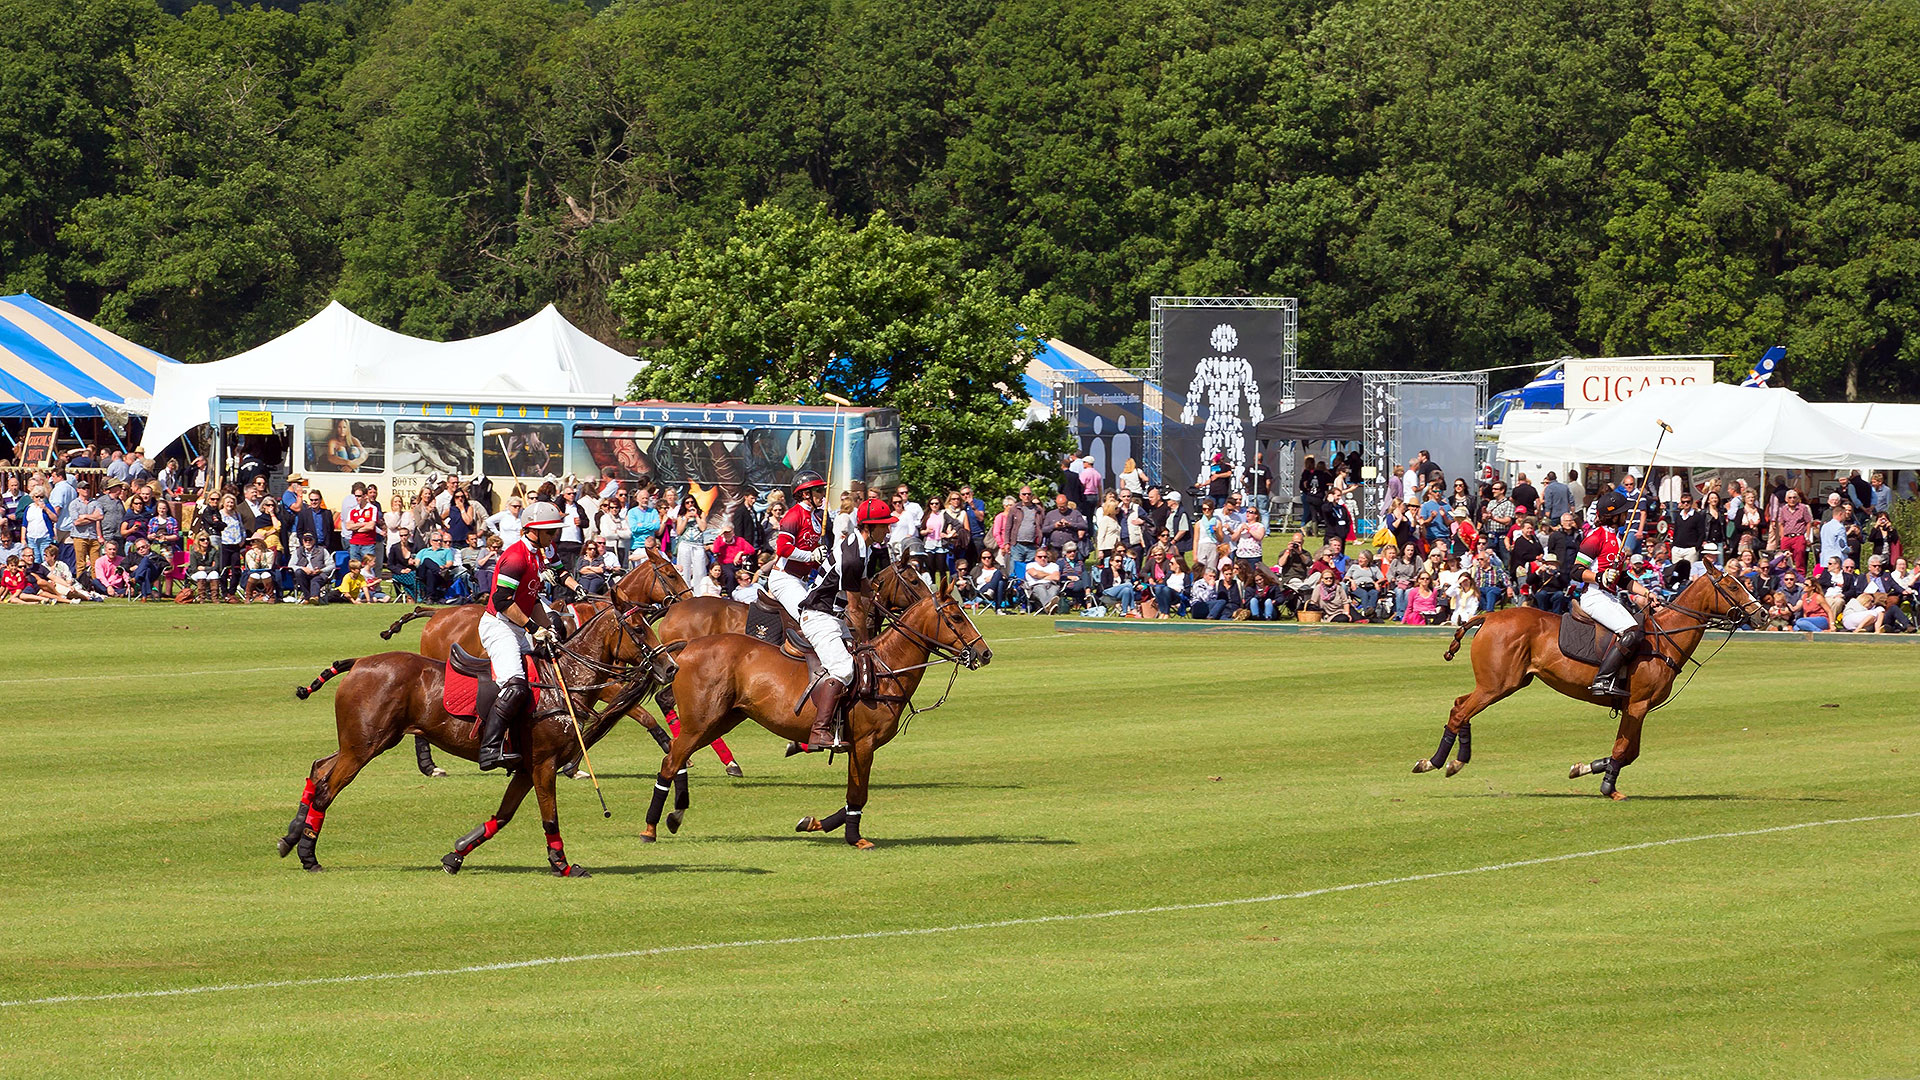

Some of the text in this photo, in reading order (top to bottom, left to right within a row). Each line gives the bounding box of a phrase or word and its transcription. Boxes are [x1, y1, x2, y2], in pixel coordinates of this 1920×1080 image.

[1584, 365, 1696, 373] AUTHENTIC HAND ROLLED CUBAN
[392, 477, 418, 487] BOOTS
